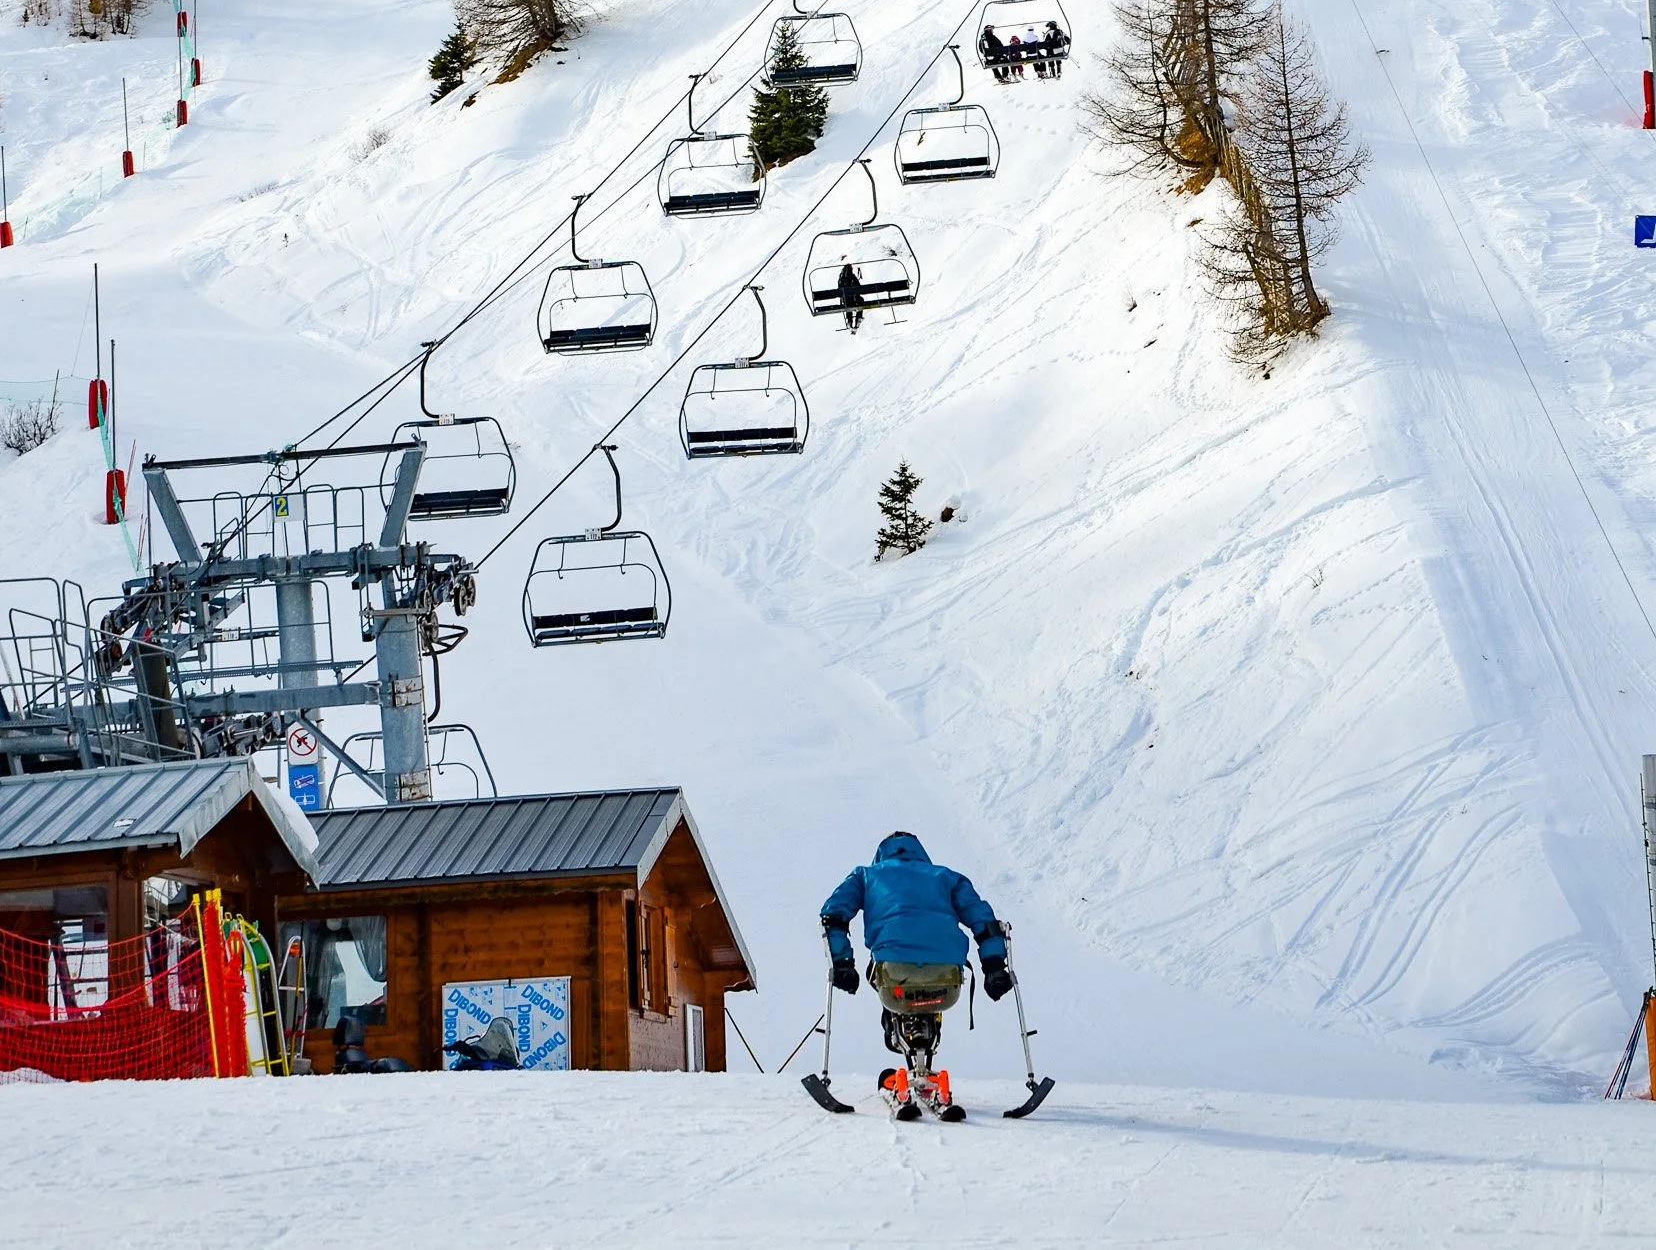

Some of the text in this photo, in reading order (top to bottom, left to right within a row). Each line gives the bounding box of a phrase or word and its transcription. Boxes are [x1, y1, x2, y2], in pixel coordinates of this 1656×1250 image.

[277, 497, 287, 516] 2
[448, 989, 491, 1025] DIBOND
[521, 984, 565, 1021] DIBOND
[518, 1004, 531, 1052] DIBOND
[523, 1031, 566, 1069] DIBOND
